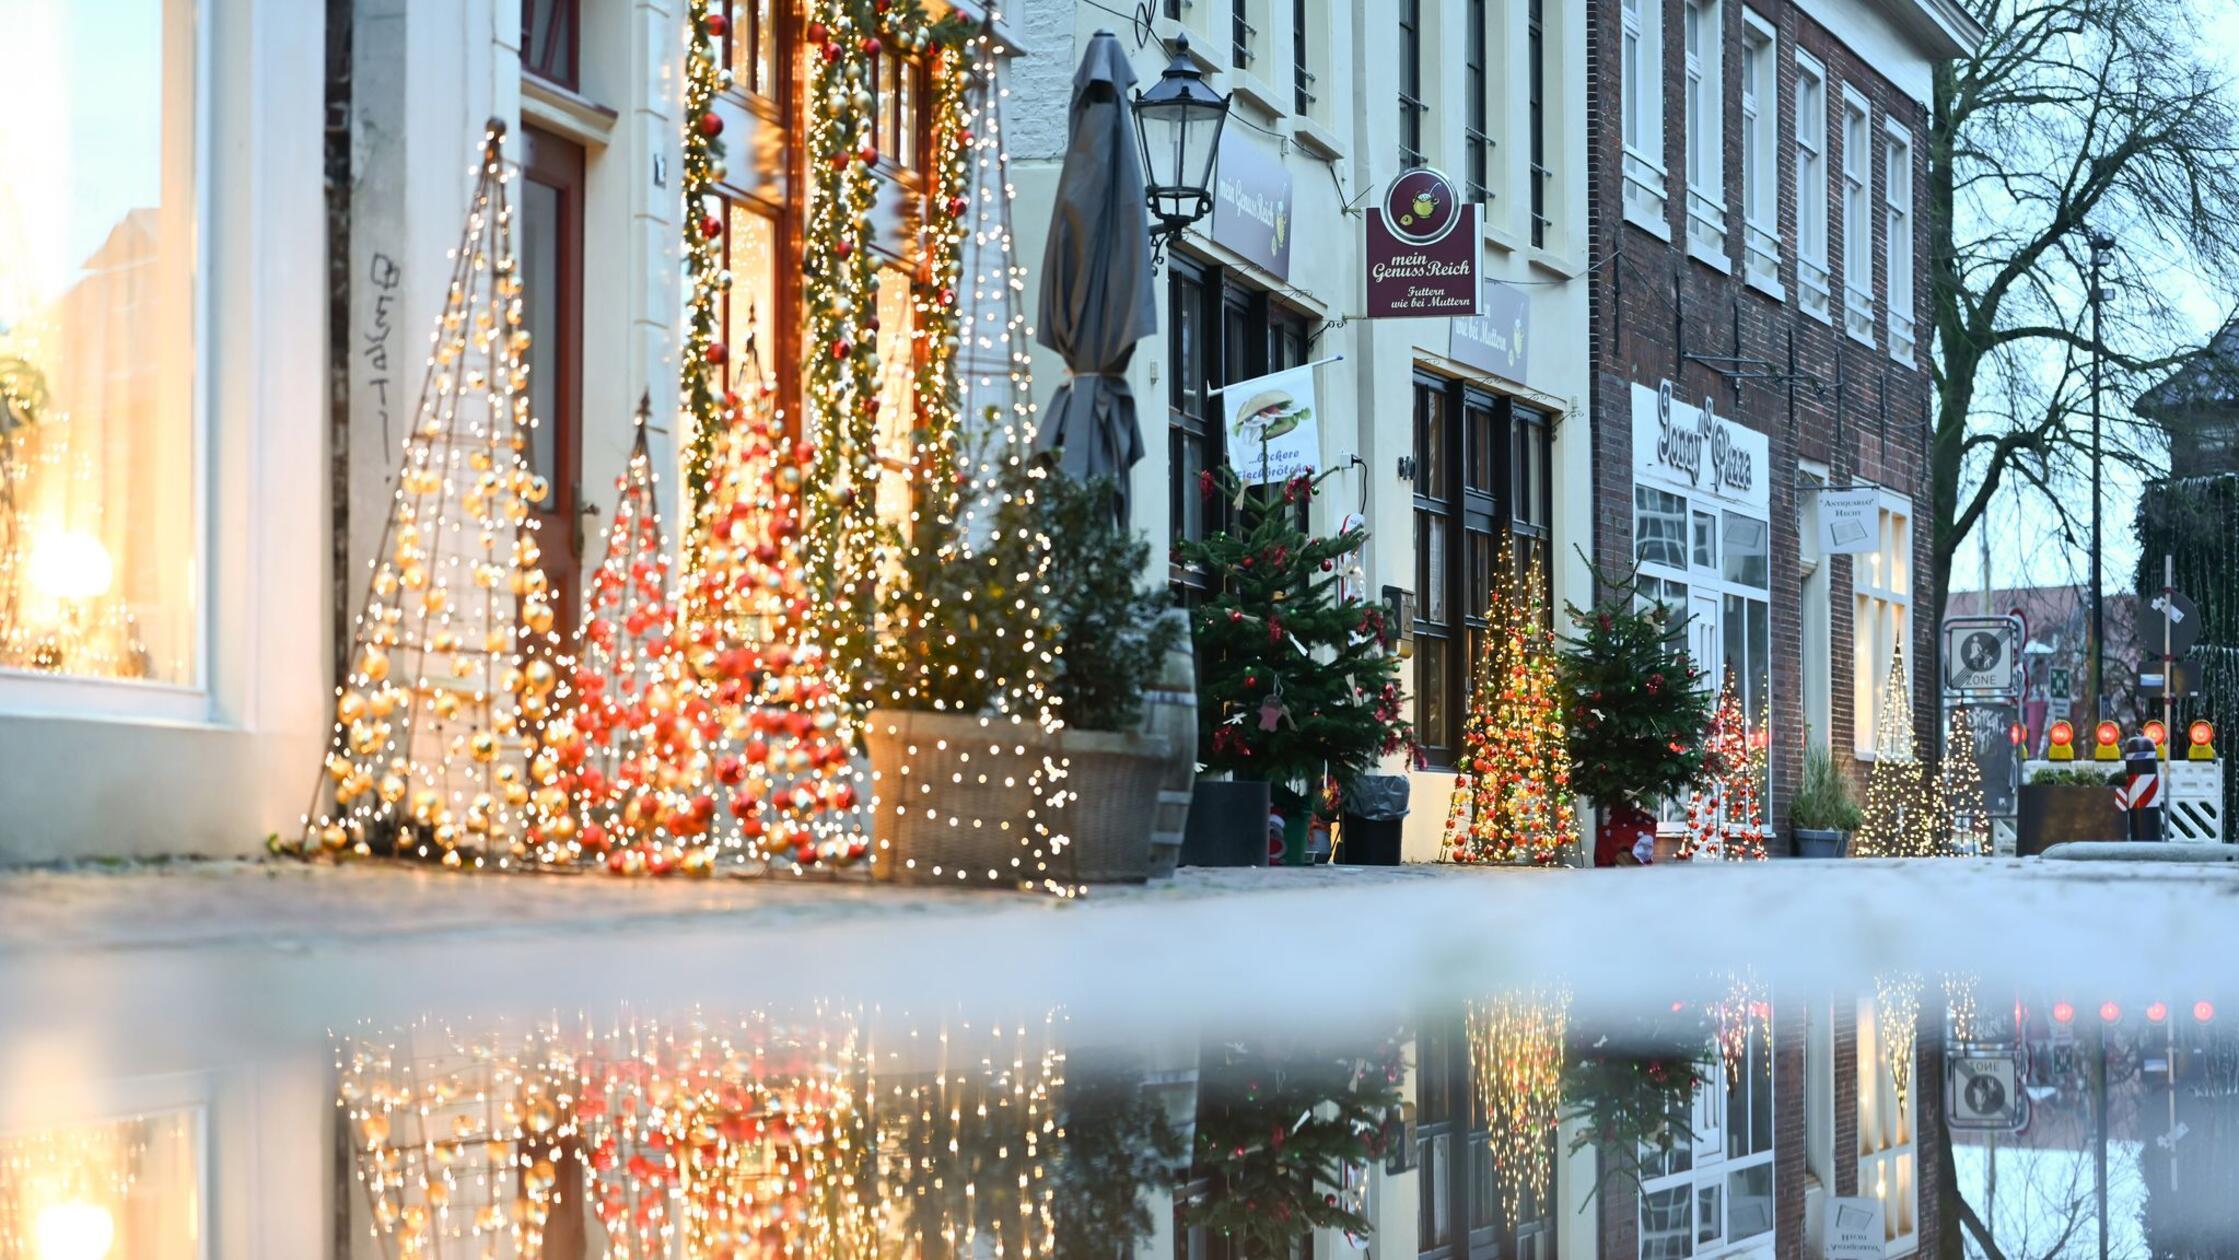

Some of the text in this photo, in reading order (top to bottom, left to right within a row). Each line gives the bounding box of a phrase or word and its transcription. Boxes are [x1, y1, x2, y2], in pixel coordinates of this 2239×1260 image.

[1219, 177, 1235, 204] mein
[1391, 251, 1427, 266] mein
[1407, 286, 1445, 297] Futtern
[1391, 296, 1470, 309] wie bei Muttern
[1468, 316, 1478, 341] bei
[1480, 320, 1507, 352] Muttern
[1711, 419, 1752, 491] Pizza
[1966, 675, 1997, 685] ZONE
